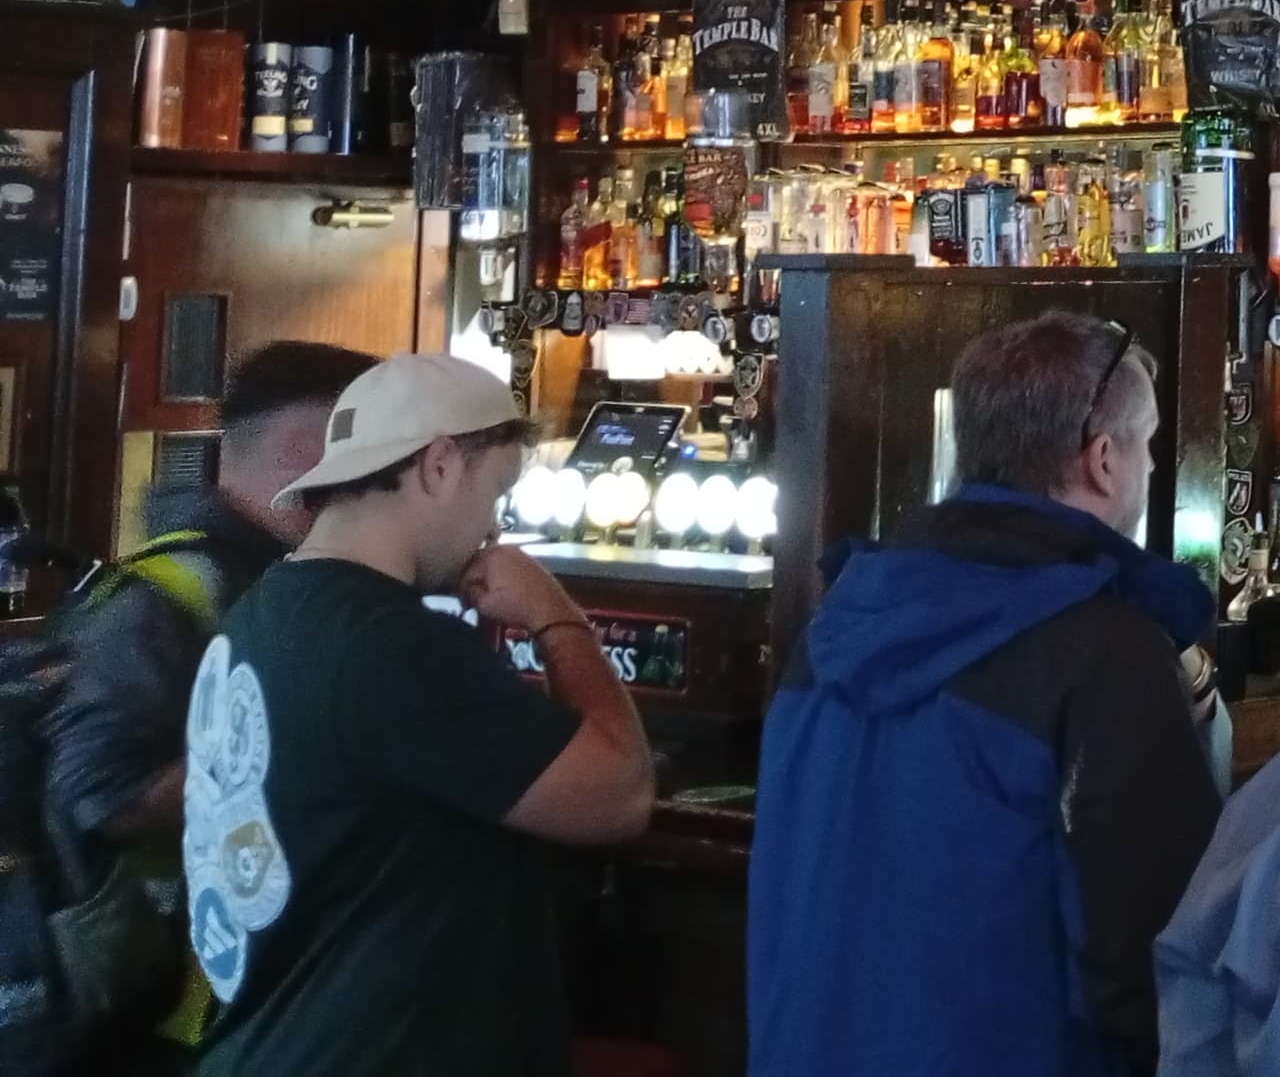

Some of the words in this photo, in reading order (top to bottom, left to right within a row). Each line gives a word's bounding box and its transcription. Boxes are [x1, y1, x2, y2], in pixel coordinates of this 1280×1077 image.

[728, 6, 748, 18] THE
[692, 21, 749, 56] TEMPLE
[750, 17, 779, 52] BAR
[1180, 221, 1213, 244] JAME
